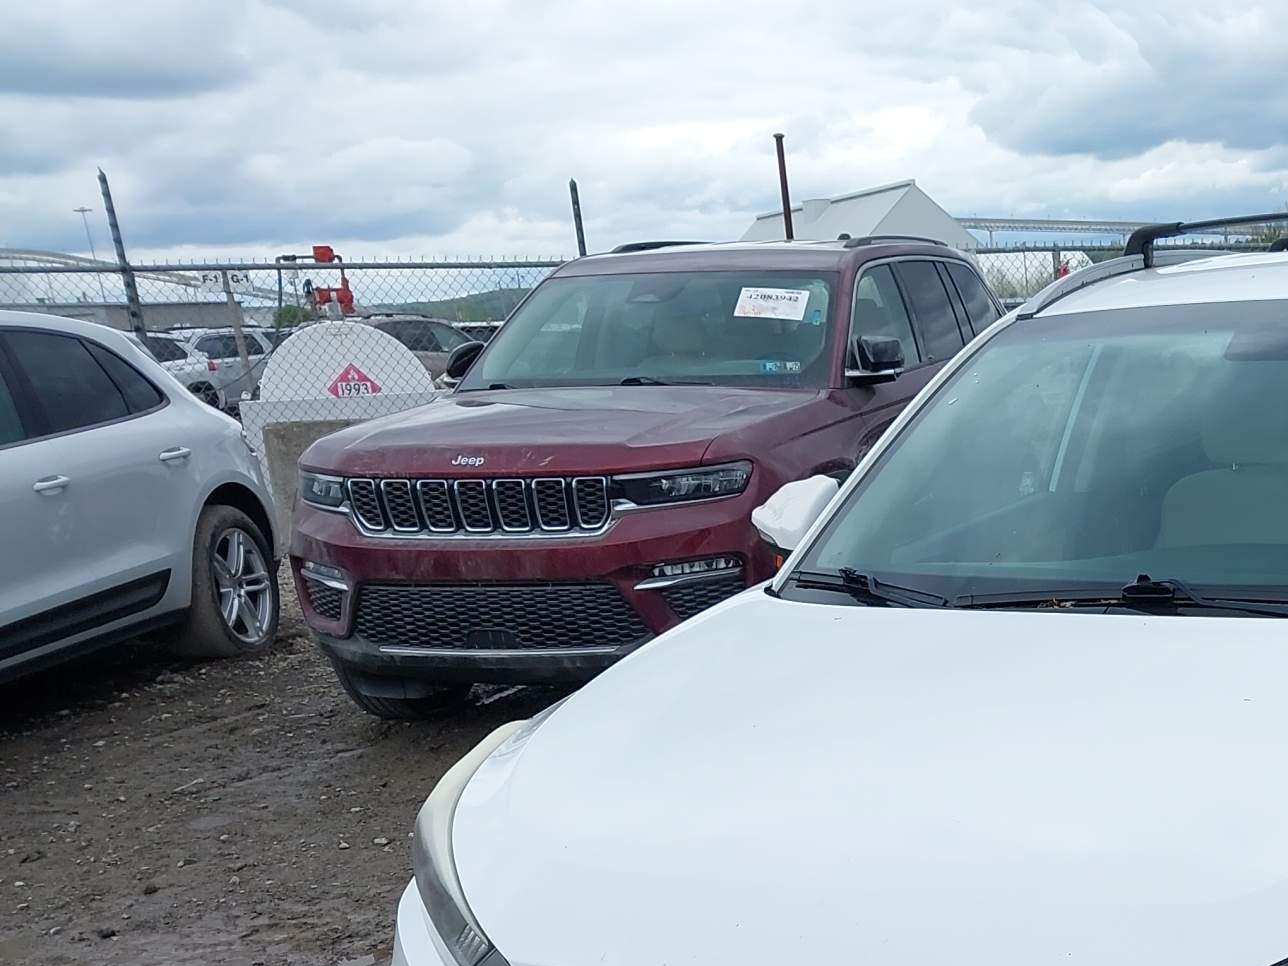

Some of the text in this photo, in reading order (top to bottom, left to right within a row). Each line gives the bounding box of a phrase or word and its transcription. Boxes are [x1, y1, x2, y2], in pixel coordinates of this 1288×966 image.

[202, 274, 218, 283] F-1
[231, 274, 249, 283] G-1
[340, 382, 370, 396] 1993
[451, 455, 485, 467] Jeep
